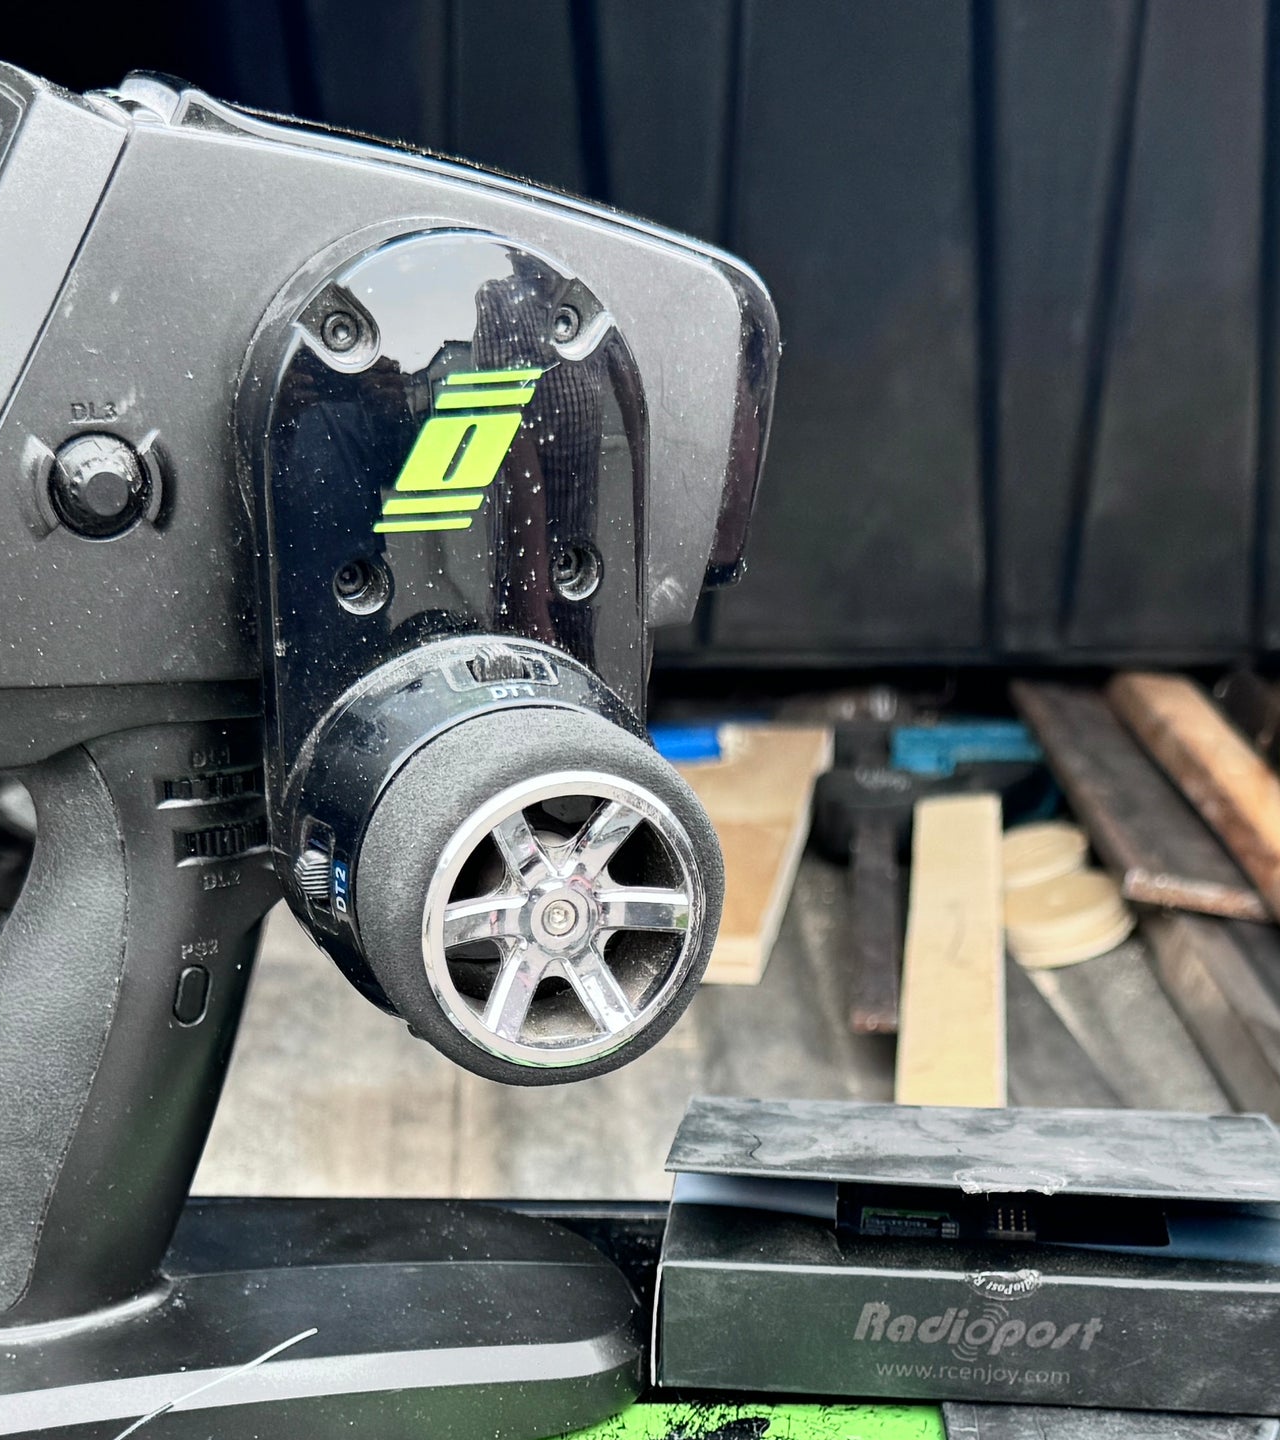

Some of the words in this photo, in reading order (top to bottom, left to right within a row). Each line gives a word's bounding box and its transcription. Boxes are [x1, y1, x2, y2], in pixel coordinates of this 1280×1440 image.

[71, 402, 119, 423] DL3
[490, 684, 535, 700] DT1
[334, 866, 349, 914] DT2
[853, 1301, 1105, 1356] Radiopost
[875, 1361, 1071, 1386] www.rcenjoy.com
